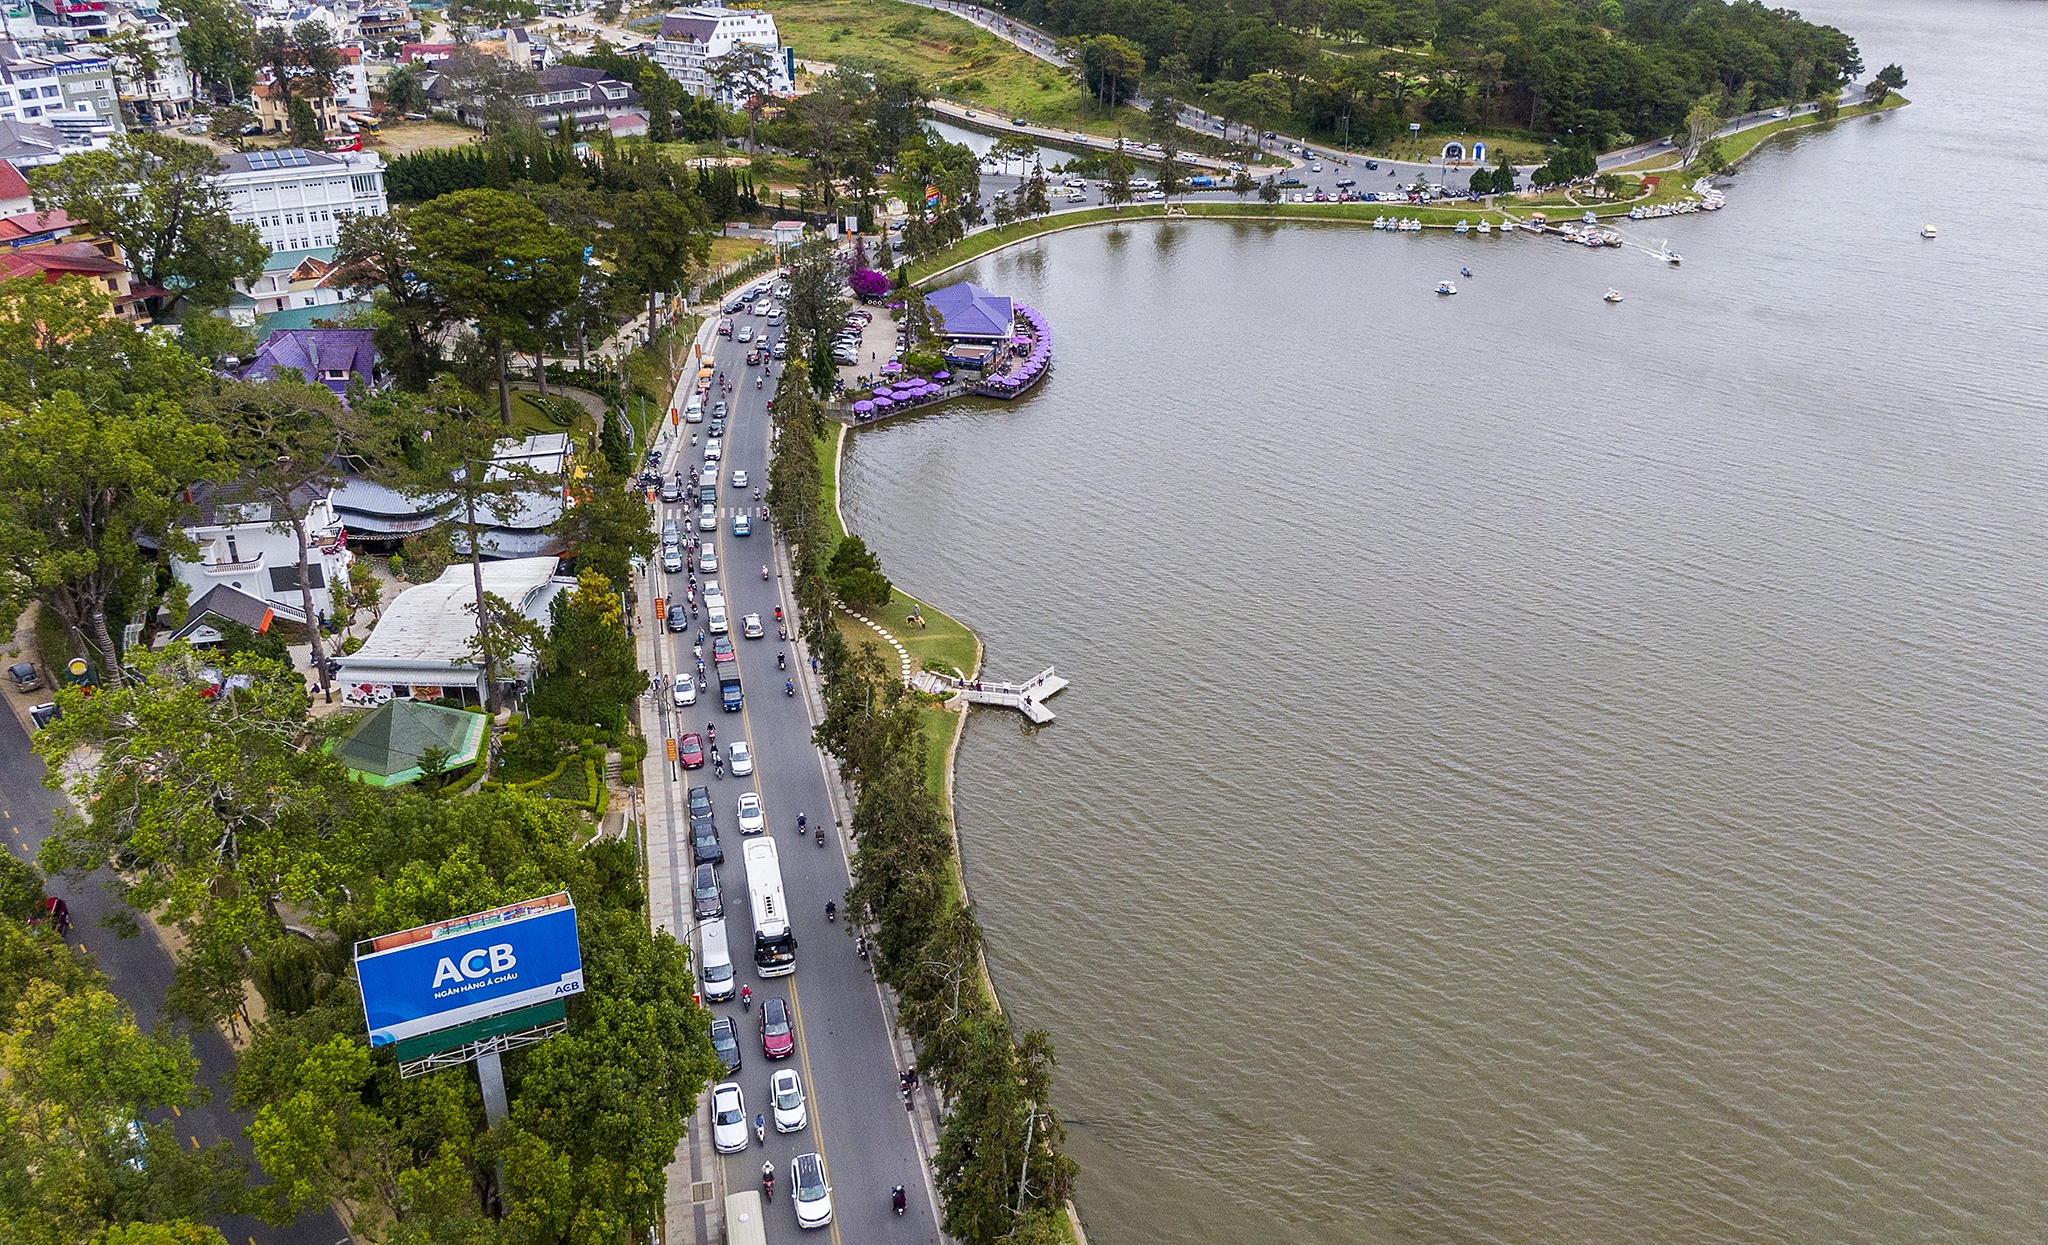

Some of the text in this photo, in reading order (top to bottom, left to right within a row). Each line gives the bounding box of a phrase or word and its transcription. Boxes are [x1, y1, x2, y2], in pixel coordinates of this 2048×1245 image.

[432, 943, 517, 988] ACB
[434, 987, 460, 999] NGÂN
[460, 980, 486, 993] HÀNG
[494, 972, 518, 985] CHÂU
[554, 981, 580, 995] ACB
